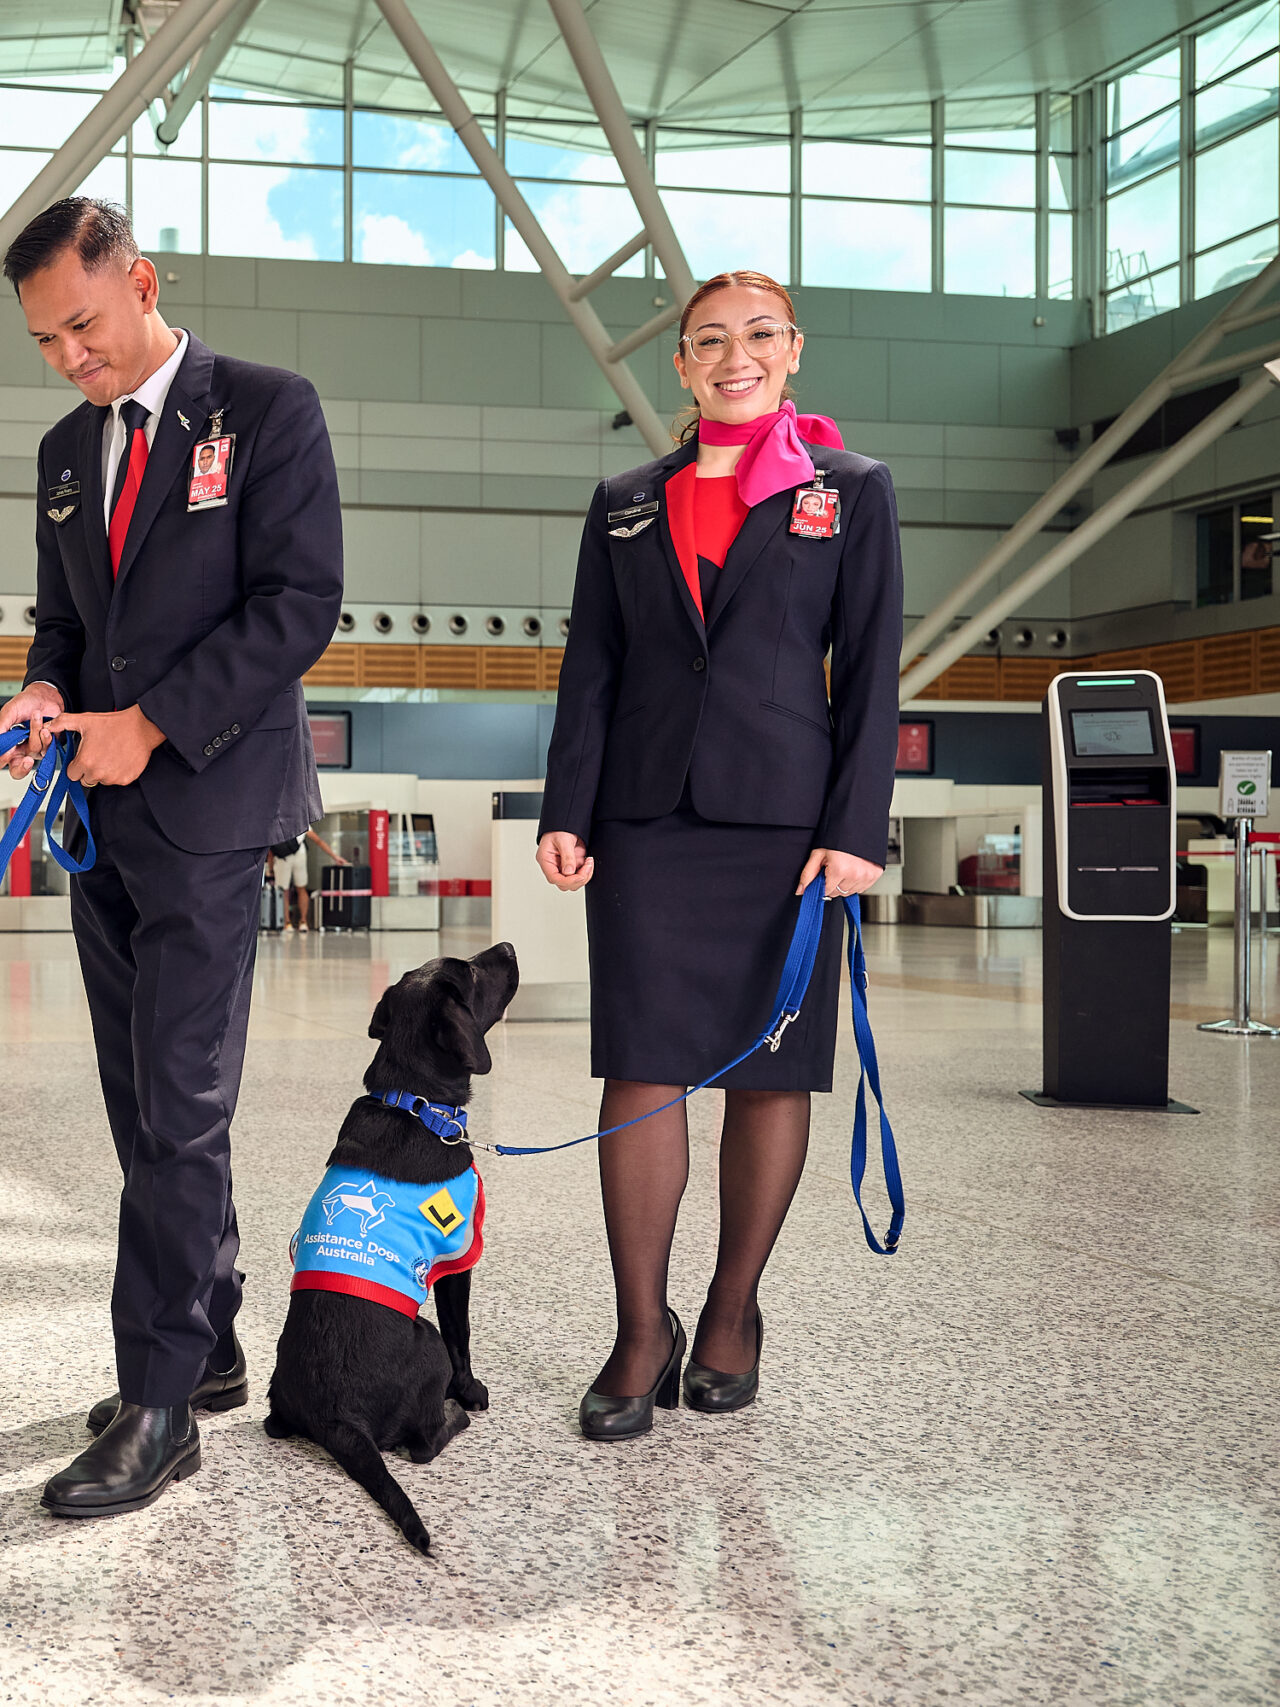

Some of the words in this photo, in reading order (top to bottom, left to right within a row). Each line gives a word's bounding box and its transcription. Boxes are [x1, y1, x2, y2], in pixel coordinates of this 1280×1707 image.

[191, 486, 211, 498] MAY
[211, 484, 222, 493] 25
[793, 523, 813, 531] JUN
[428, 1204, 456, 1228] L
[304, 1232, 363, 1250] Assistance
[367, 1241, 400, 1264] Dogs
[316, 1245, 375, 1266] Australia
